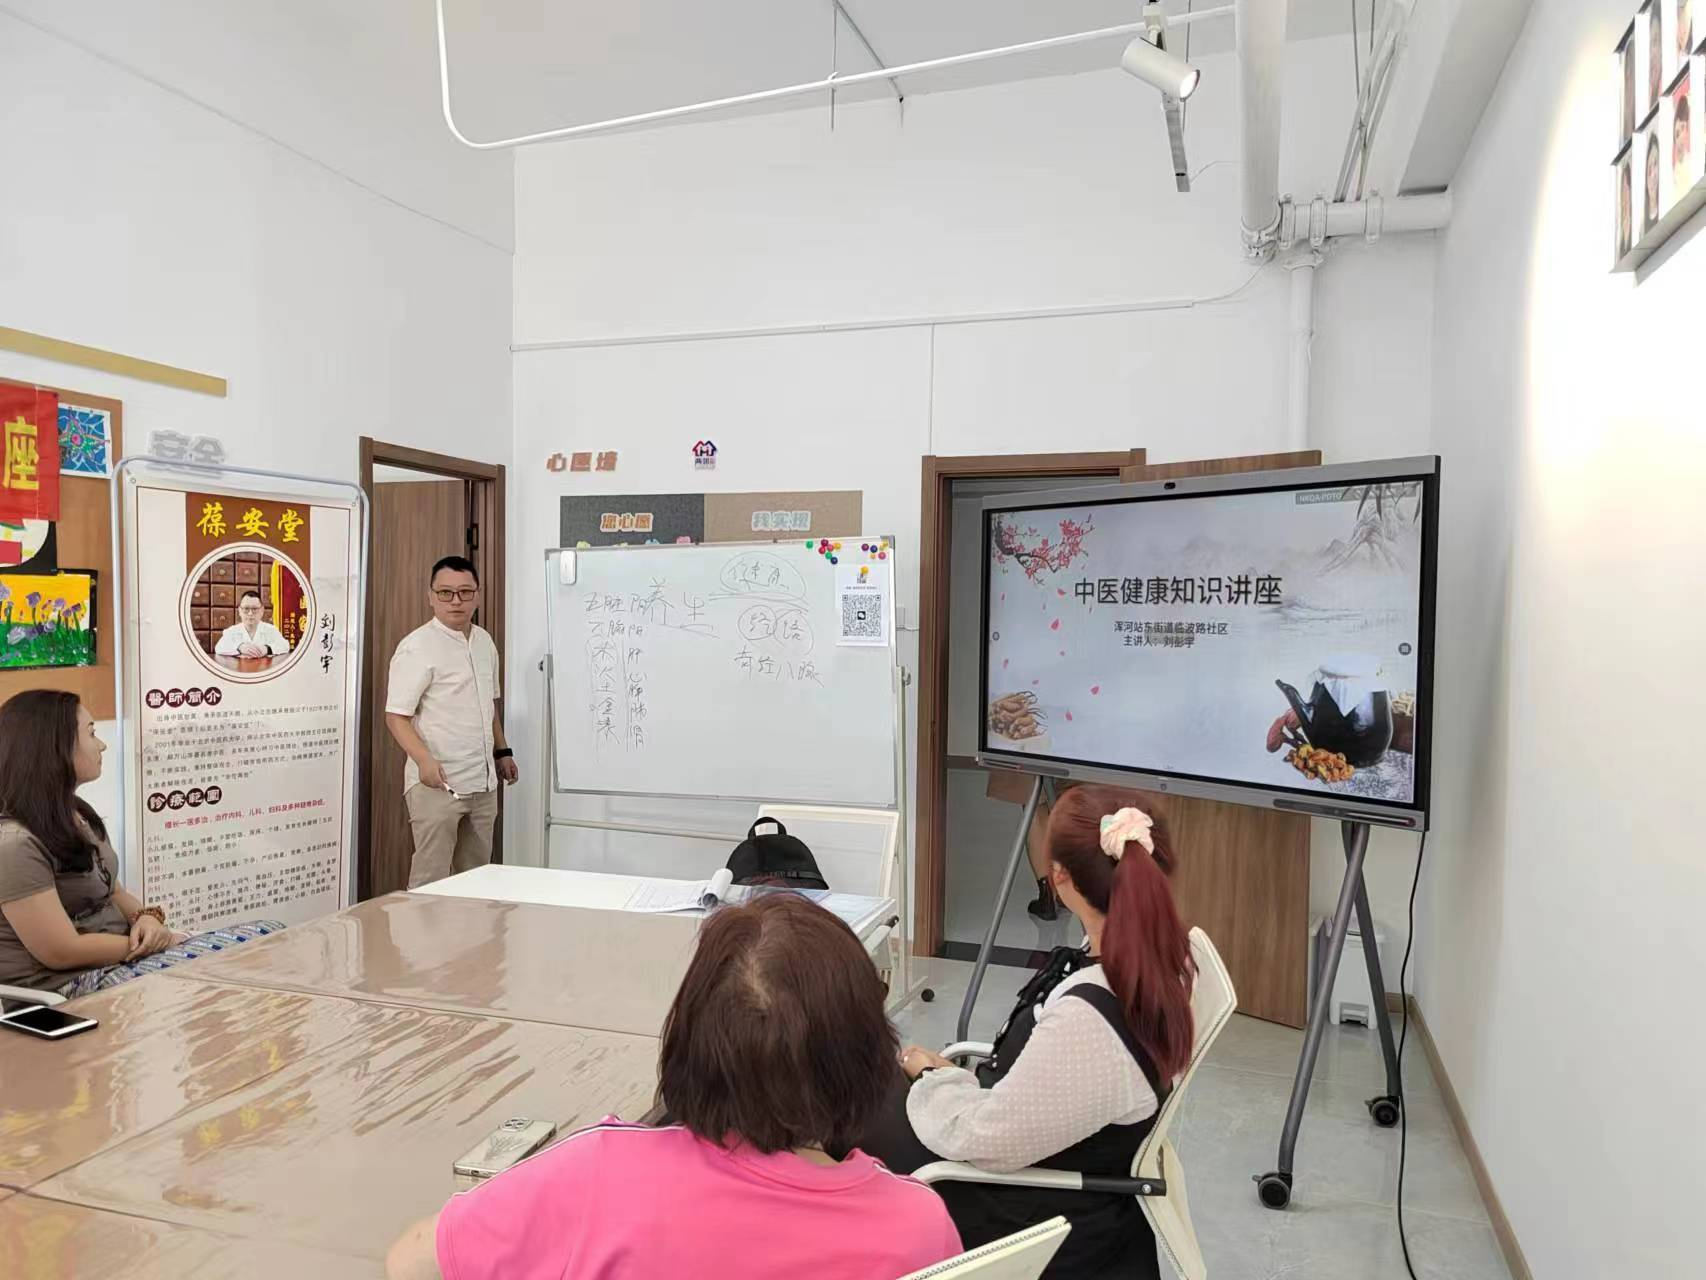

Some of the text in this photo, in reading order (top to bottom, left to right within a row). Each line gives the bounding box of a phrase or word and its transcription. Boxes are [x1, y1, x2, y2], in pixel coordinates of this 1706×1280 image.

[3, 416, 39, 490] 座
[196, 502, 304, 542] 葆安堂
[1074, 575, 1282, 605] 中医健康知识讲座
